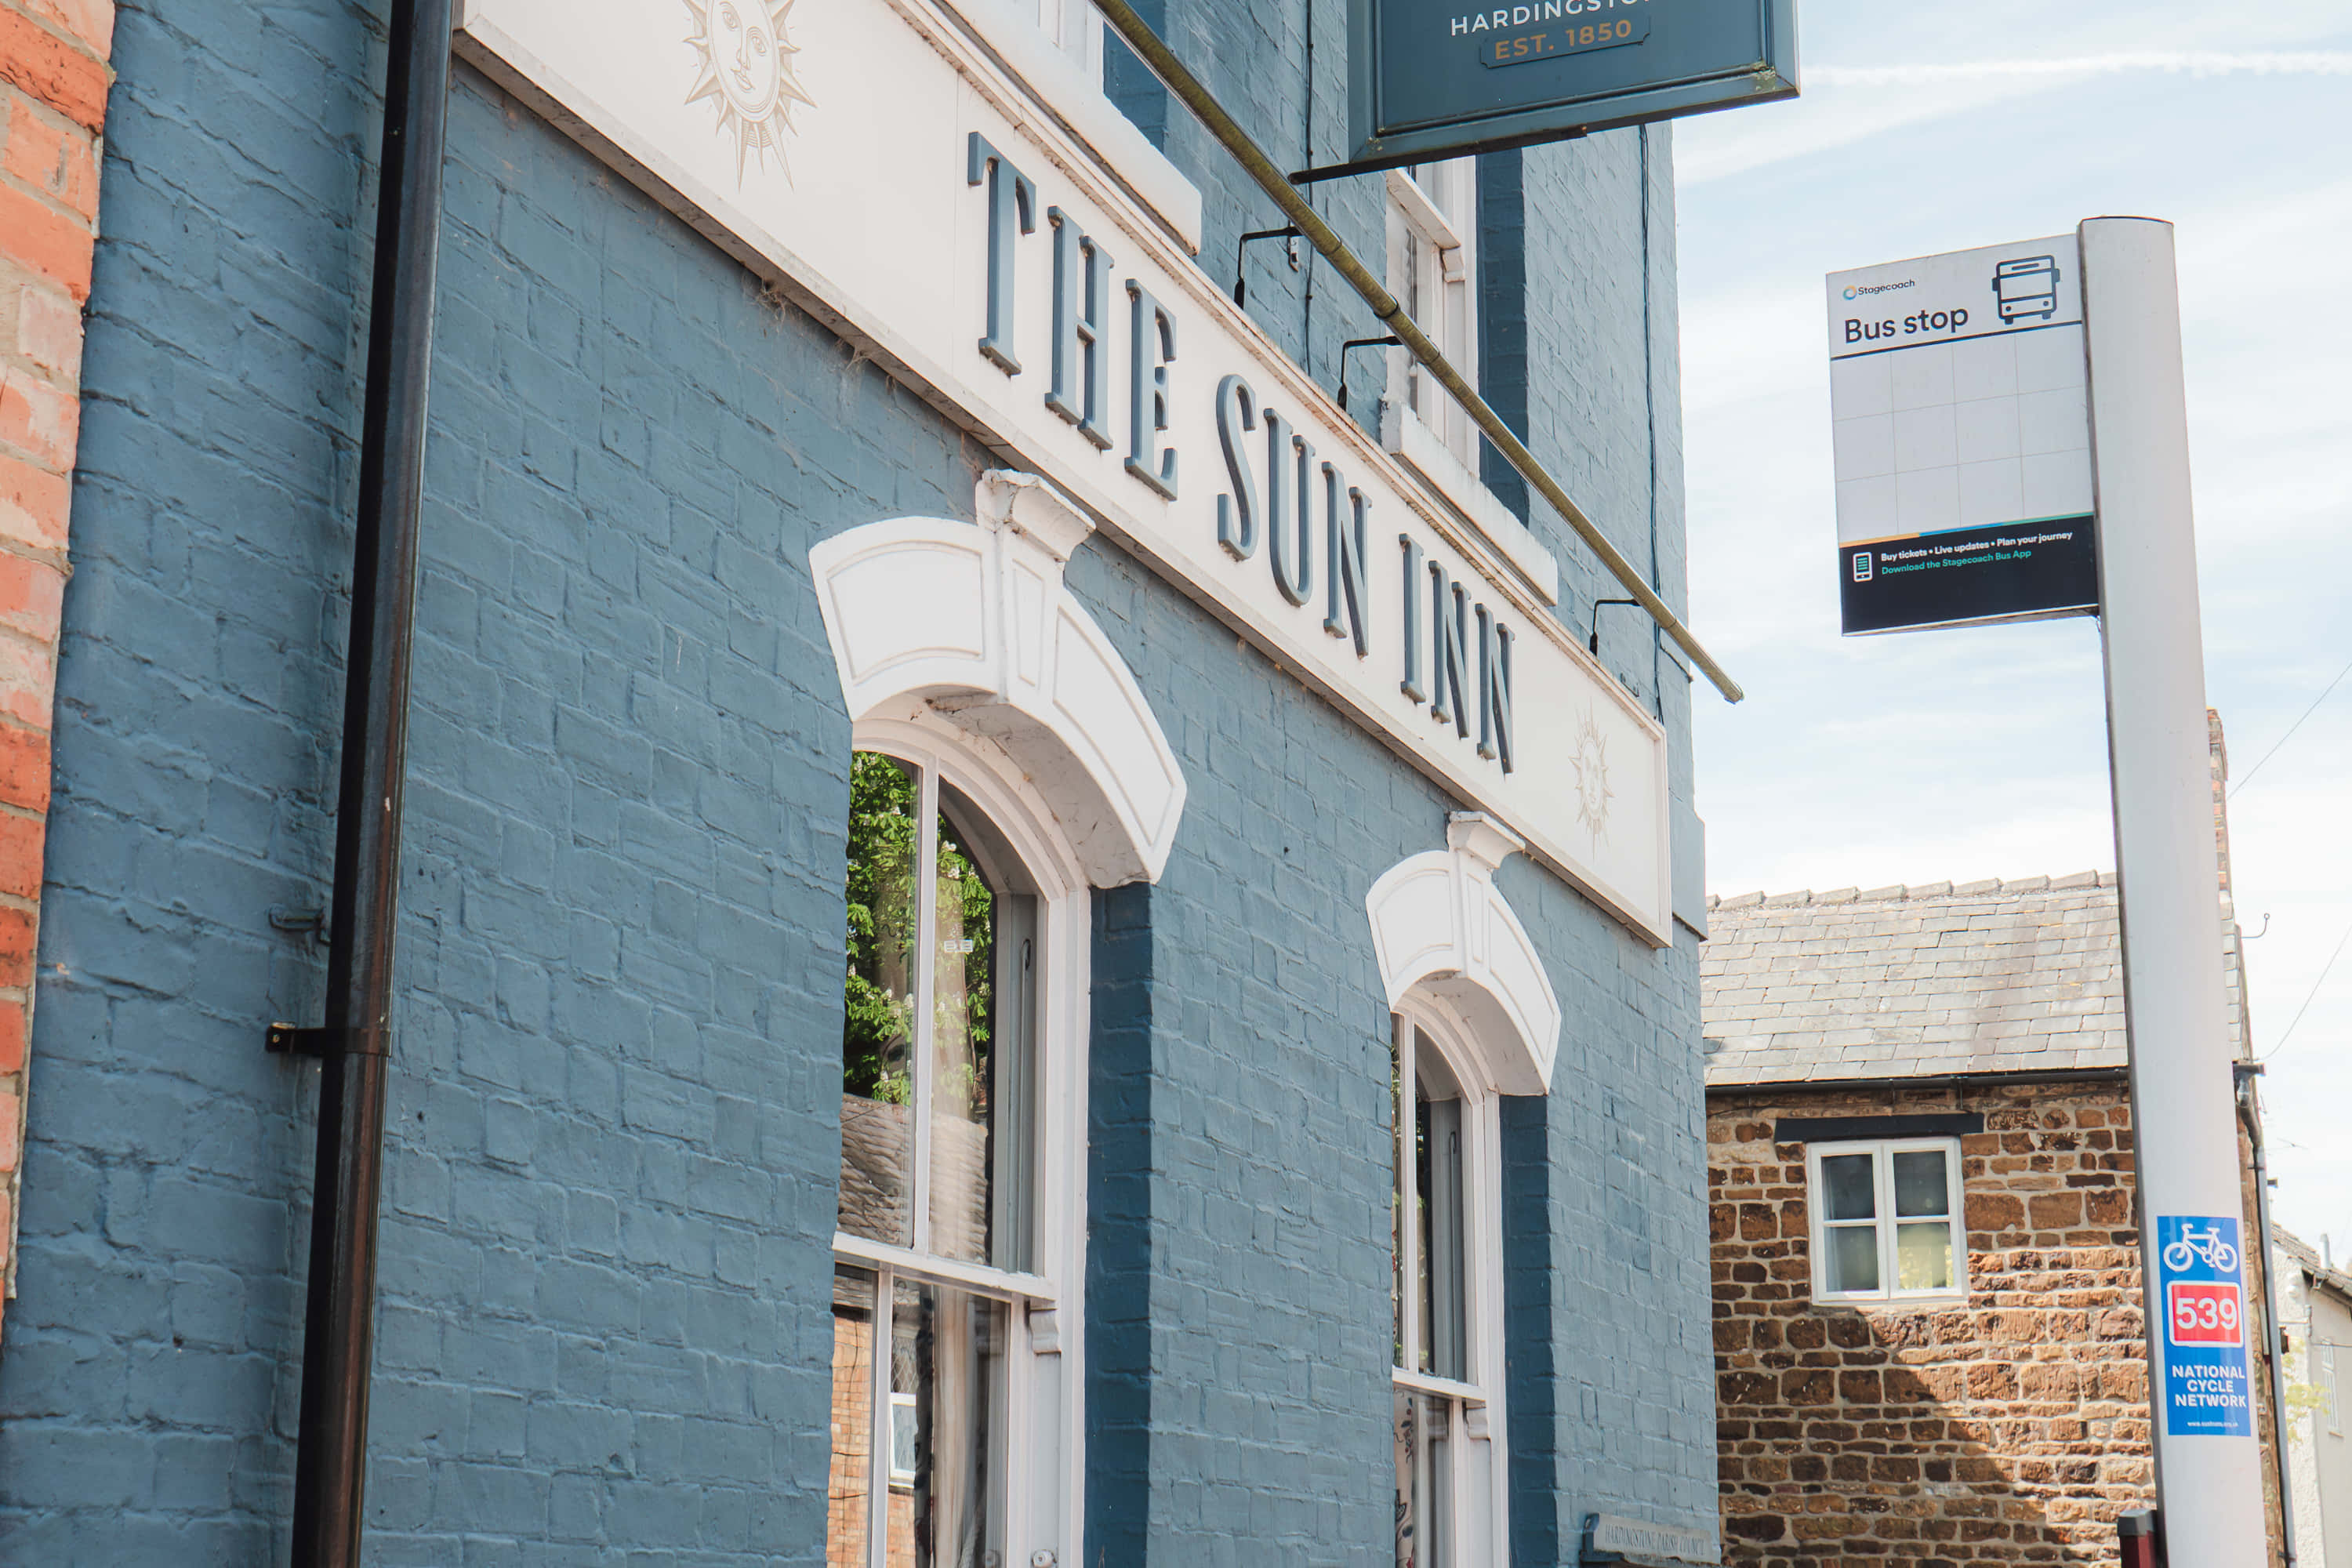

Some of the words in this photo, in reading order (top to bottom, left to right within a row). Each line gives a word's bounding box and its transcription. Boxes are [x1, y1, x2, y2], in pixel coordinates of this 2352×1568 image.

[1451, 0, 1648, 36] HARDINGS
[1495, 34, 1554, 60] EST.
[1565, 20, 1631, 46] 1850
[1857, 279, 1915, 296] Stagecoach
[1845, 318, 1896, 343] Bus
[1904, 307, 1969, 333] stop
[967, 132, 1178, 502] THE
[1215, 374, 1372, 657] SUN
[1399, 533, 1515, 774] INN
[1882, 553, 1897, 562] Buy
[1898, 550, 1928, 559] tickets
[1934, 546, 1953, 555] Live
[1955, 542, 1990, 553] updates
[1997, 537, 2016, 546] Plan
[2016, 535, 2038, 546] your
[2038, 532, 2073, 543] journey
[1882, 561, 1926, 575] Download
[1926, 561, 1940, 569] the
[1942, 554, 1994, 568] Stagecoach
[1995, 552, 2012, 561] Bus
[2013, 550, 2032, 559] App
[2176, 1298, 2238, 1330] 539
[2172, 1365, 2245, 1380] NATIONAL
[2187, 1380, 2234, 1393] CYCLE
[2175, 1394, 2247, 1408] NETWORK
